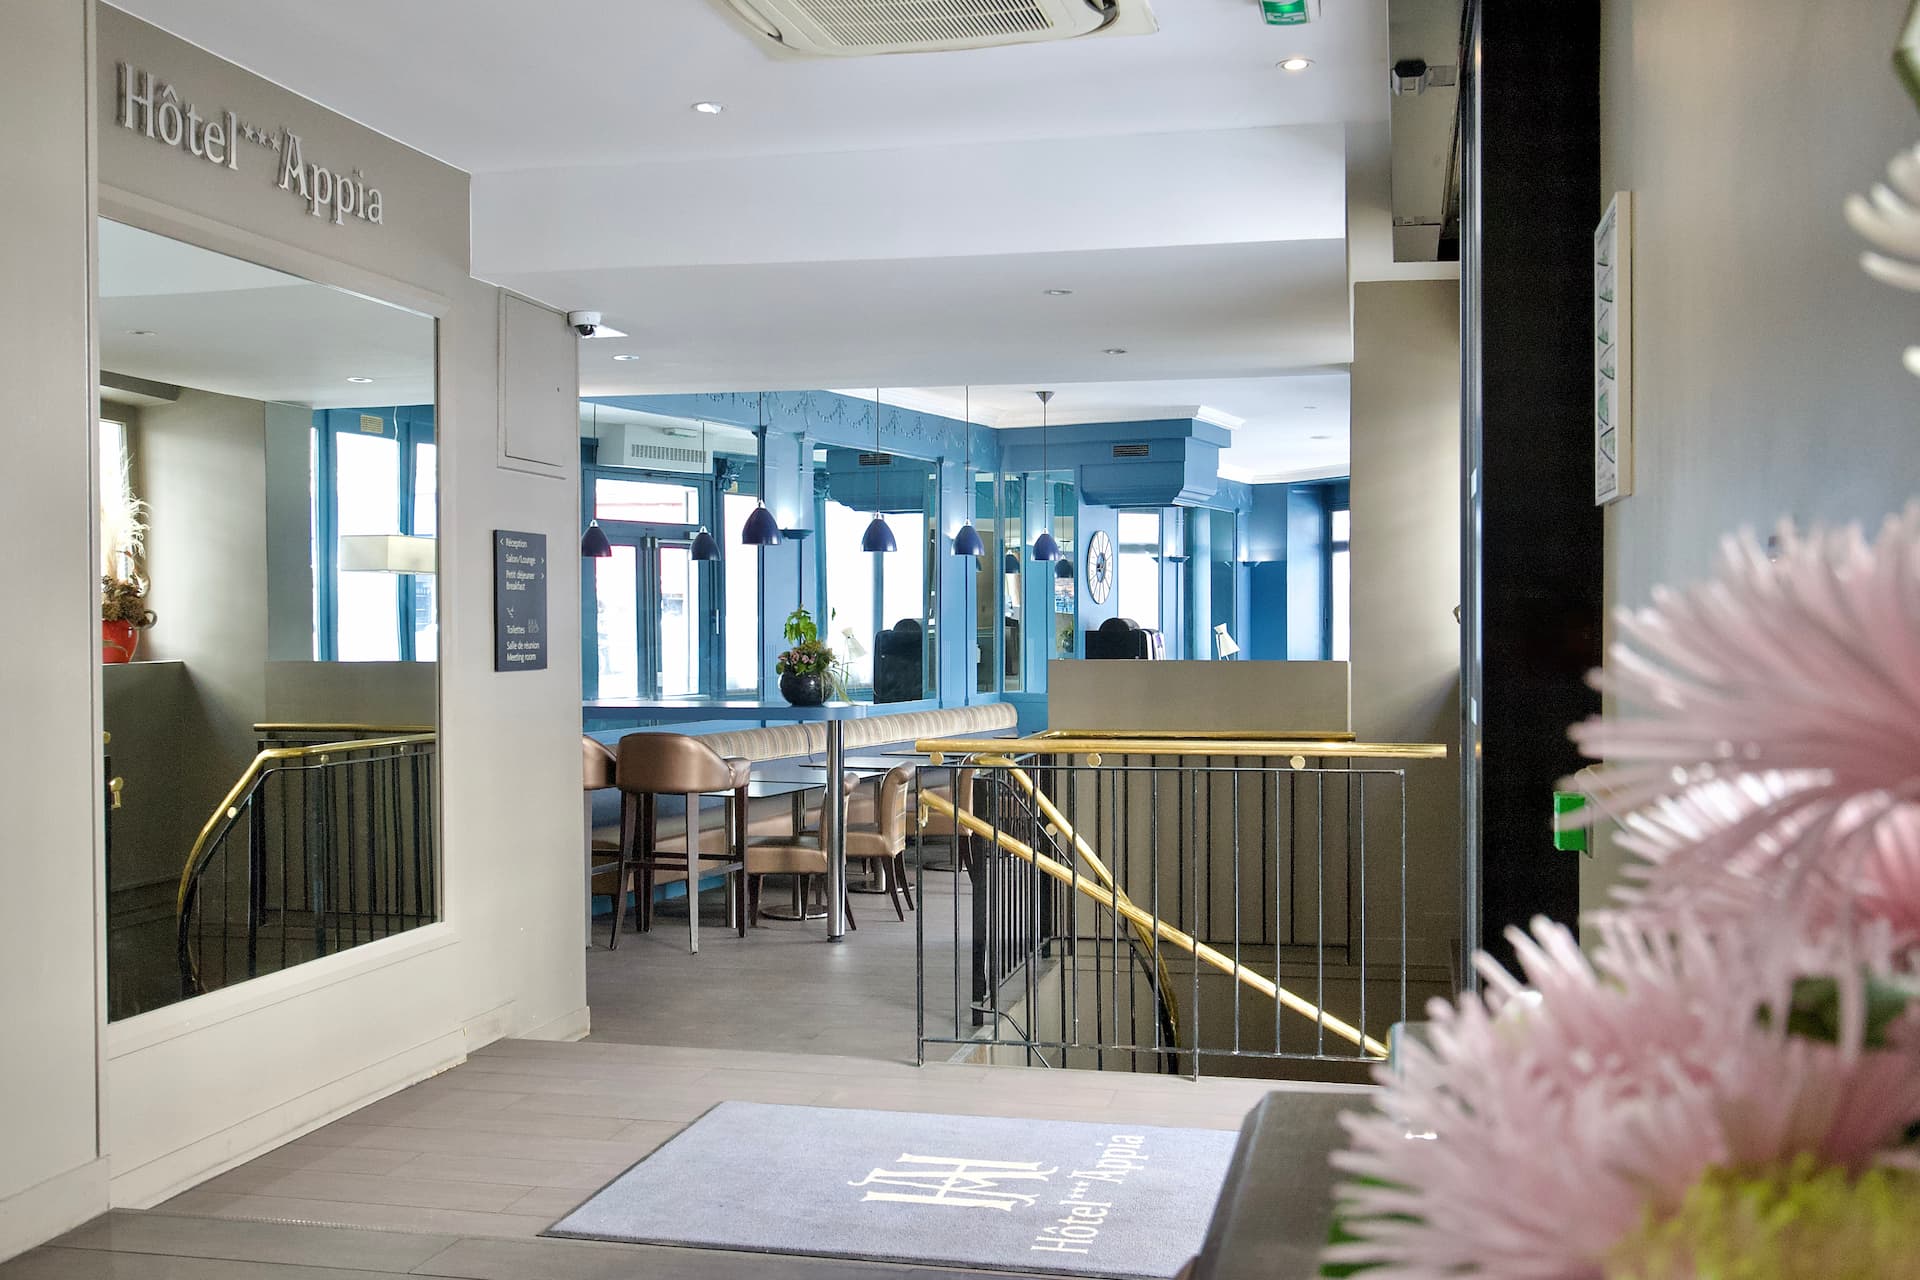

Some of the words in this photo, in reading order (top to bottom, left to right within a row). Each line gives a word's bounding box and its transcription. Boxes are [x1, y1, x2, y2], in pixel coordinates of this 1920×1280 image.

[123, 61, 239, 170] Hôtel
[278, 127, 384, 226] Appia
[505, 581, 526, 591] Breakfast
[506, 625, 526, 634] Toilettes
[506, 641, 517, 650] Salle
[523, 640, 540, 650] réunion
[506, 653, 525, 663] Meeting
[524, 653, 537, 661] room
[1066, 1133, 1149, 1185] Appia
[1030, 1198, 1113, 1255] Hôtel
